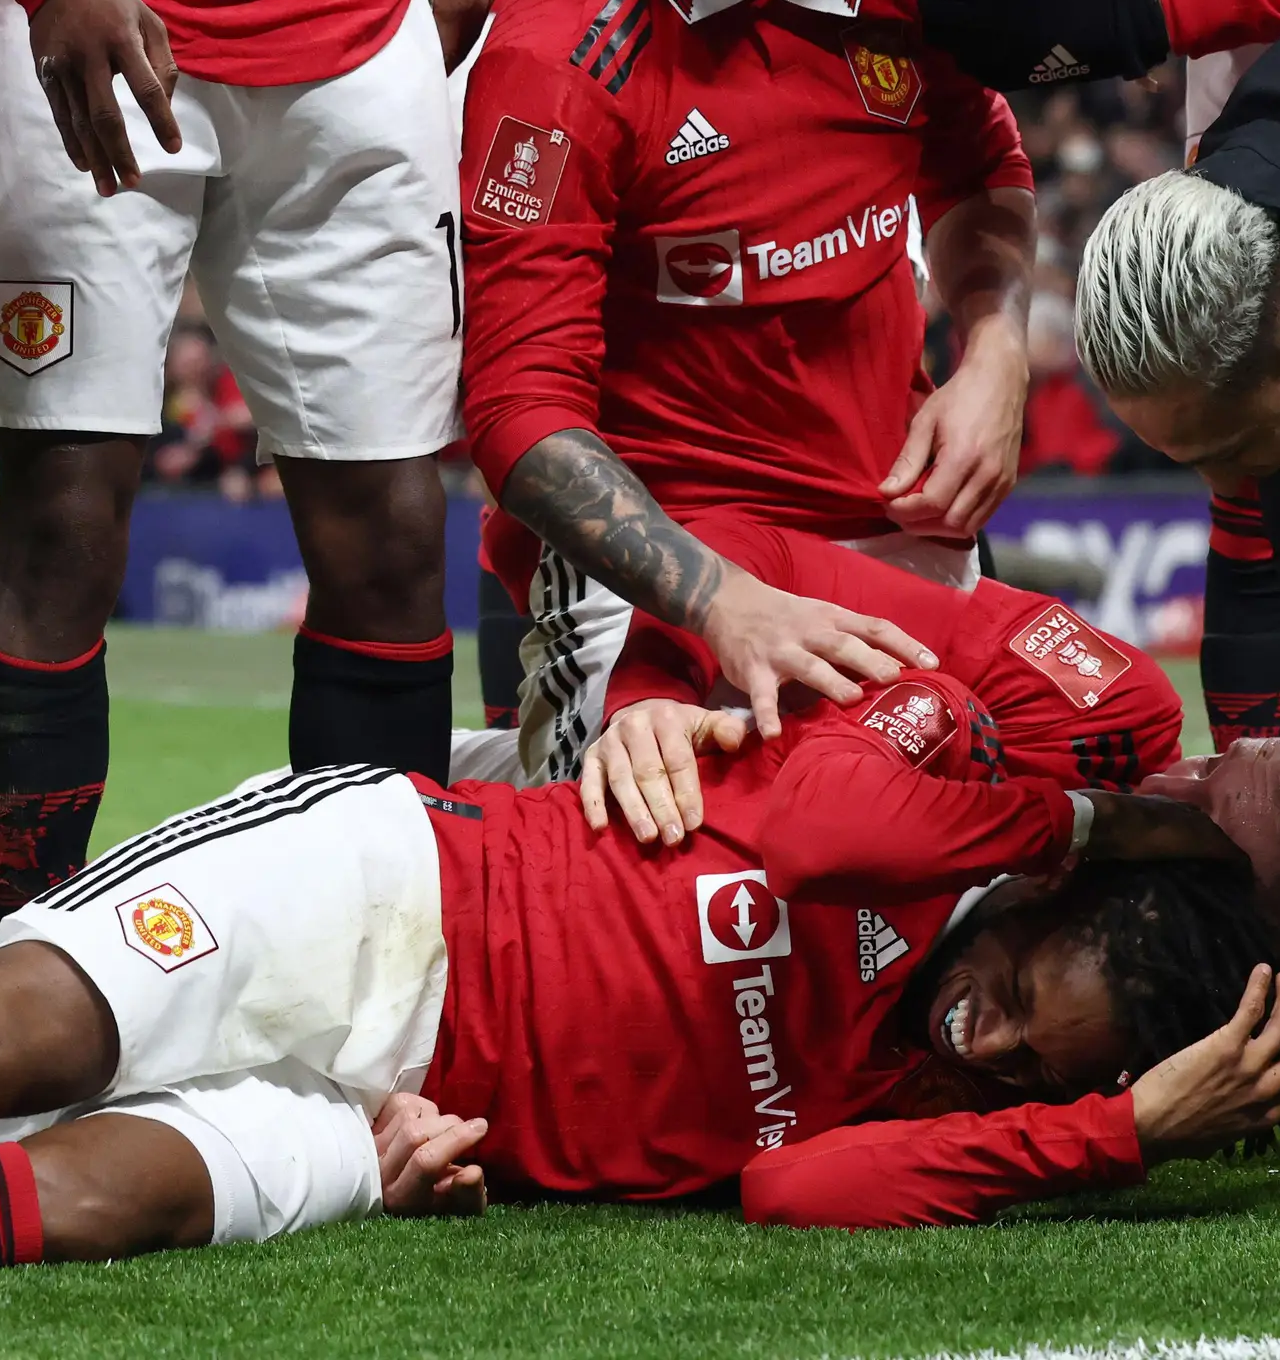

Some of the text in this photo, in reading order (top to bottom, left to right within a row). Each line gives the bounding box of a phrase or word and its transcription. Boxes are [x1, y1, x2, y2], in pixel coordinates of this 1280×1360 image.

[1028, 64, 1090, 83] adidas
[881, 83, 907, 102] UNITED
[664, 133, 731, 166] adidas
[481, 193, 540, 223] FA CUP
[486, 178, 543, 209] Emirates
[6, 295, 58, 320] MANCHESTER
[12, 342, 50, 355] UNITED
[1024, 612, 1068, 652] FA CUP
[1033, 623, 1080, 660] Emirates
[863, 719, 920, 755] FA CUP
[870, 710, 927, 749] Emirates
[135, 919, 162, 950] UNITED
[154, 901, 192, 946] MANCHESTER
[856, 908, 876, 983] adidas
